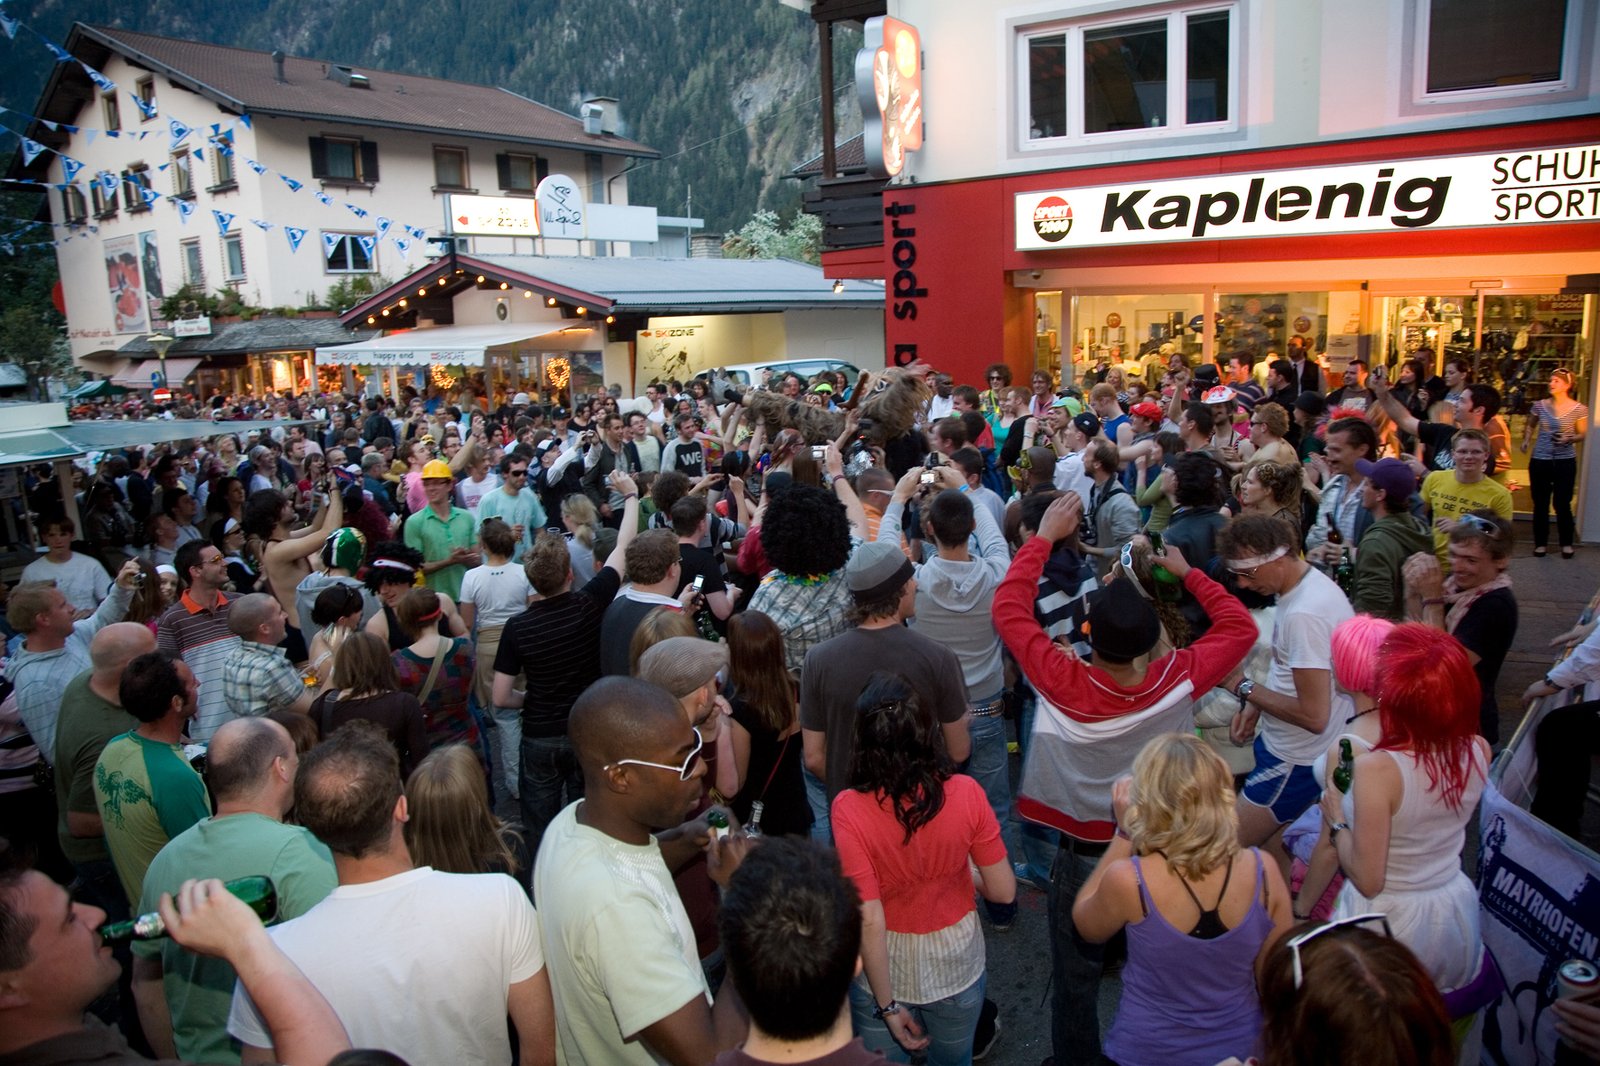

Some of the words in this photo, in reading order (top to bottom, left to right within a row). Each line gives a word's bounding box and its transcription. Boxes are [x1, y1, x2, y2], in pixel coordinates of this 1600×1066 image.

[1034, 204, 1070, 220] SPORT
[1100, 168, 1452, 239] Kaplenig
[1494, 188, 1600, 221] SPORT
[1037, 219, 1070, 234] 2000
[885, 201, 928, 320] sport
[655, 328, 695, 339] SKIZONE
[373, 352, 396, 361] happy
[400, 351, 414, 360] end
[1487, 891, 1533, 929] ZILLERTAL
[1537, 926, 1561, 952] TIROL
[1492, 866, 1600, 960] MAYRHOFEN
